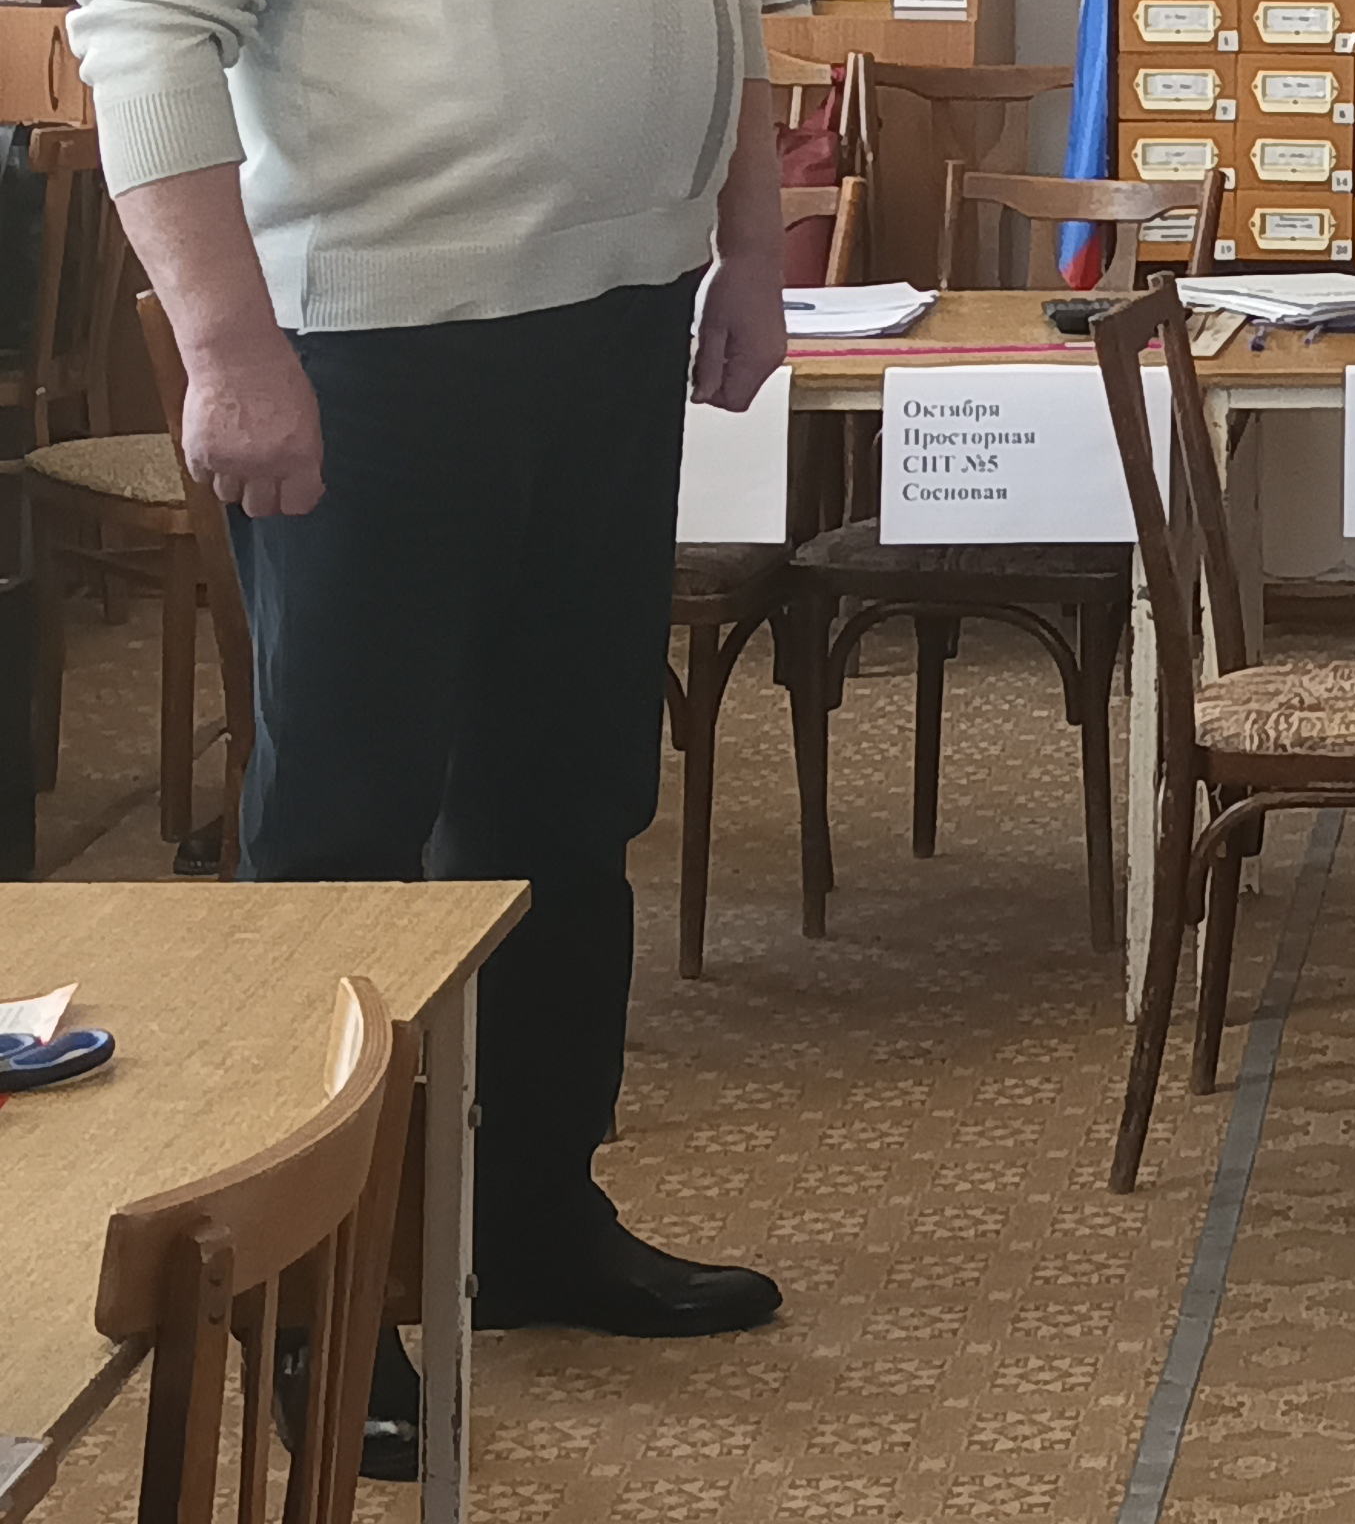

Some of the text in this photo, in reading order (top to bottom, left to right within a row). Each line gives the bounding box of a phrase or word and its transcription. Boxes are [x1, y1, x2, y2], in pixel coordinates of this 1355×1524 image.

[903, 399, 1000, 422] Октября
[904, 428, 1036, 450] Просторная
[960, 454, 999, 473] №5
[902, 482, 1008, 502] Сосновая
